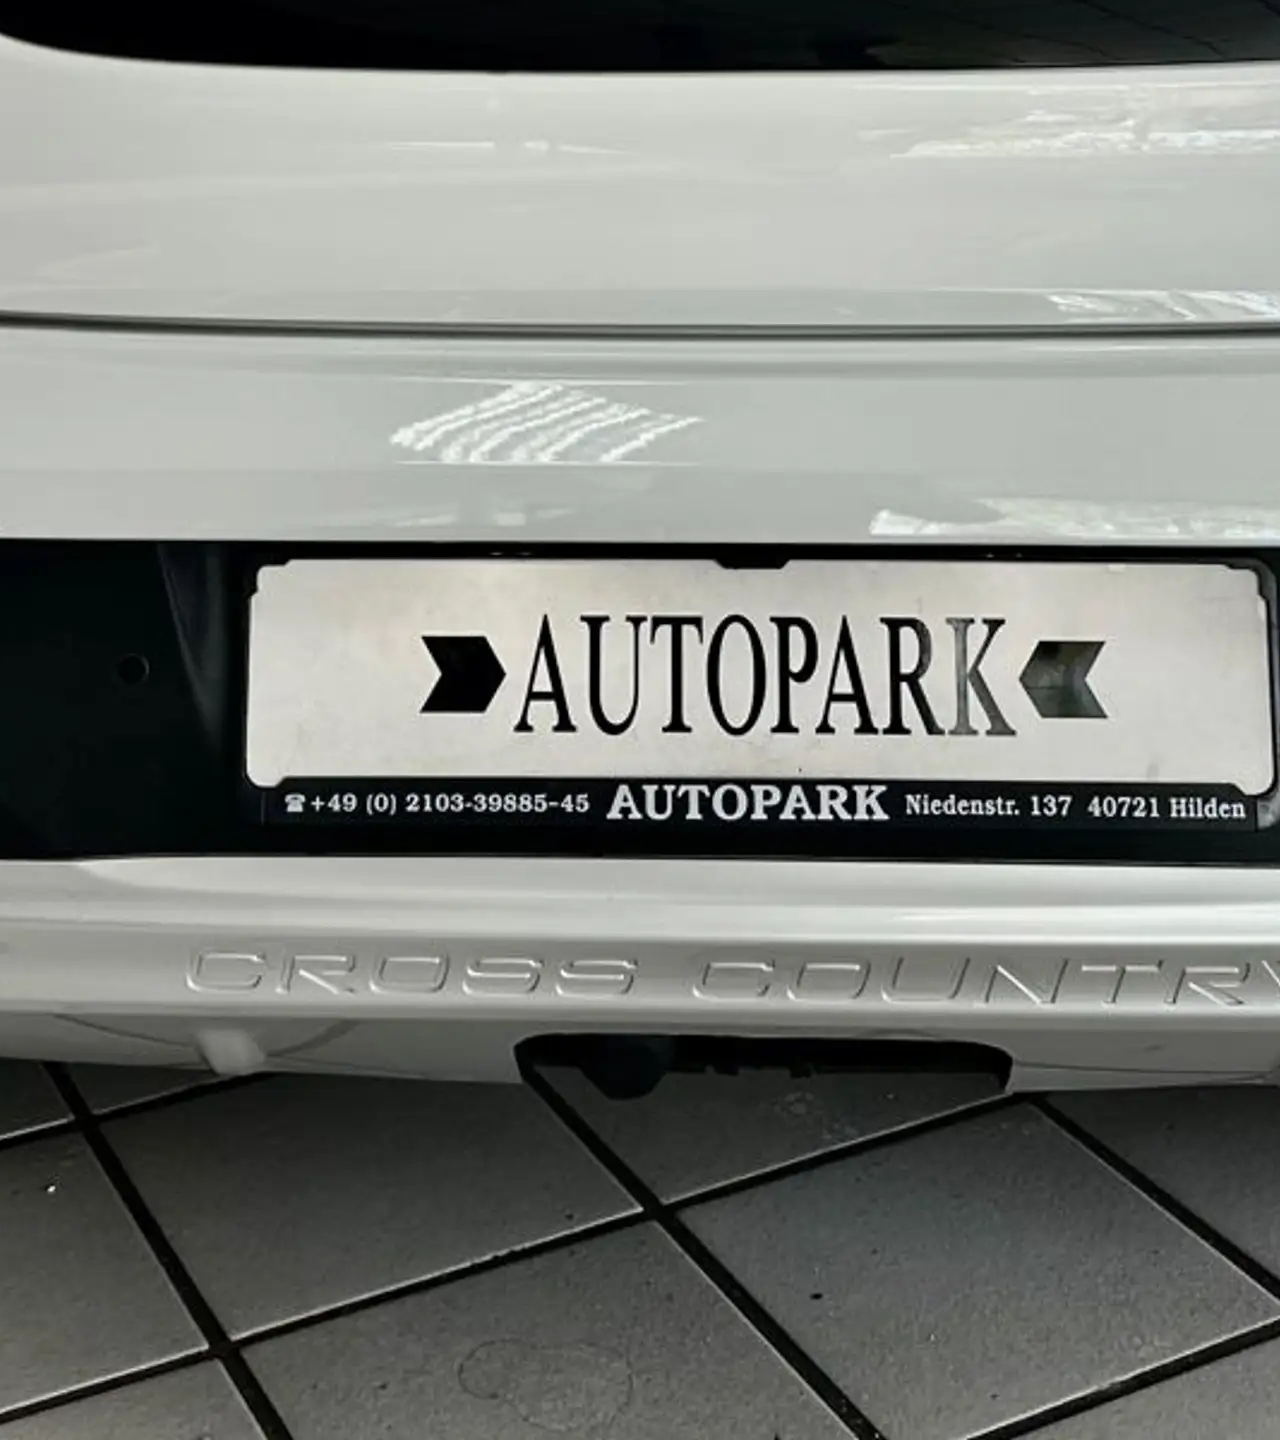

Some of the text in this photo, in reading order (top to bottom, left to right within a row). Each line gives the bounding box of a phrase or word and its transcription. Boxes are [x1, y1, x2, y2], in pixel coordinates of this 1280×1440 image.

[513, 613, 1017, 737] AUTOPARK
[311, 784, 1246, 821] +49 (0) 2103-39885-45 AUTOPARK Niedenstr. 137 40721 Hilden
[185, 952, 639, 999] CROSS
